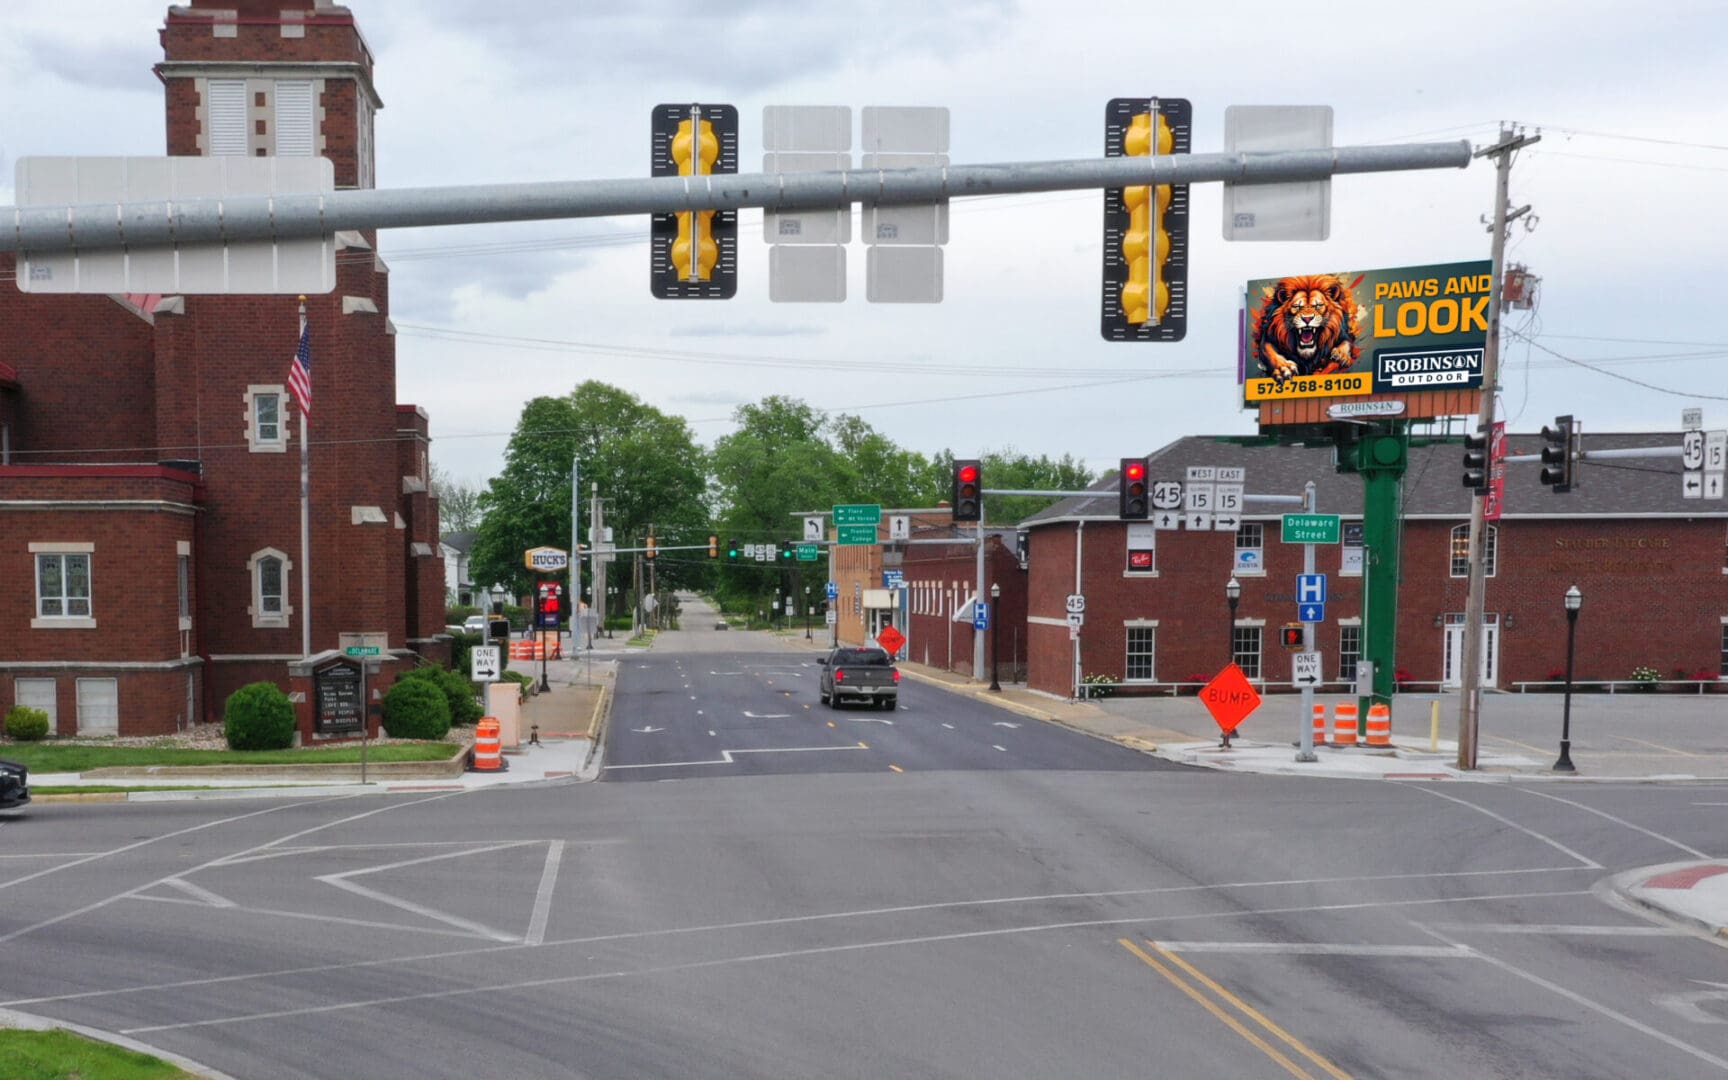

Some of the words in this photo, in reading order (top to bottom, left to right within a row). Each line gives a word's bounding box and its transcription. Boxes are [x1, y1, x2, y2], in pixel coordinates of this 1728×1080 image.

[1374, 277, 1439, 300] PAWS
[1443, 273, 1492, 296] AND
[1373, 295, 1490, 338] LOOK
[1383, 353, 1479, 374] ROBINSON
[1398, 371, 1464, 385] OUTDOOR
[1256, 377, 1362, 395] 573-768-8100
[1685, 440, 1700, 460] 45
[1710, 447, 1720, 465] 15
[1190, 469, 1212, 479] WEST
[1219, 469, 1241, 480] EAST
[1155, 486, 1179, 503] 45
[1192, 494, 1207, 507] 15
[1221, 495, 1236, 508] 15
[1288, 517, 1334, 527] Delaware
[1295, 530, 1327, 539] Street
[532, 555, 566, 565] HUCK'S
[1301, 575, 1322, 601] H
[1068, 598, 1083, 609] 45
[975, 604, 987, 617] H
[476, 649, 494, 657] ONE
[1297, 654, 1316, 663] ONE
[1296, 664, 1317, 673] WAY
[1209, 688, 1251, 705] BUMP
